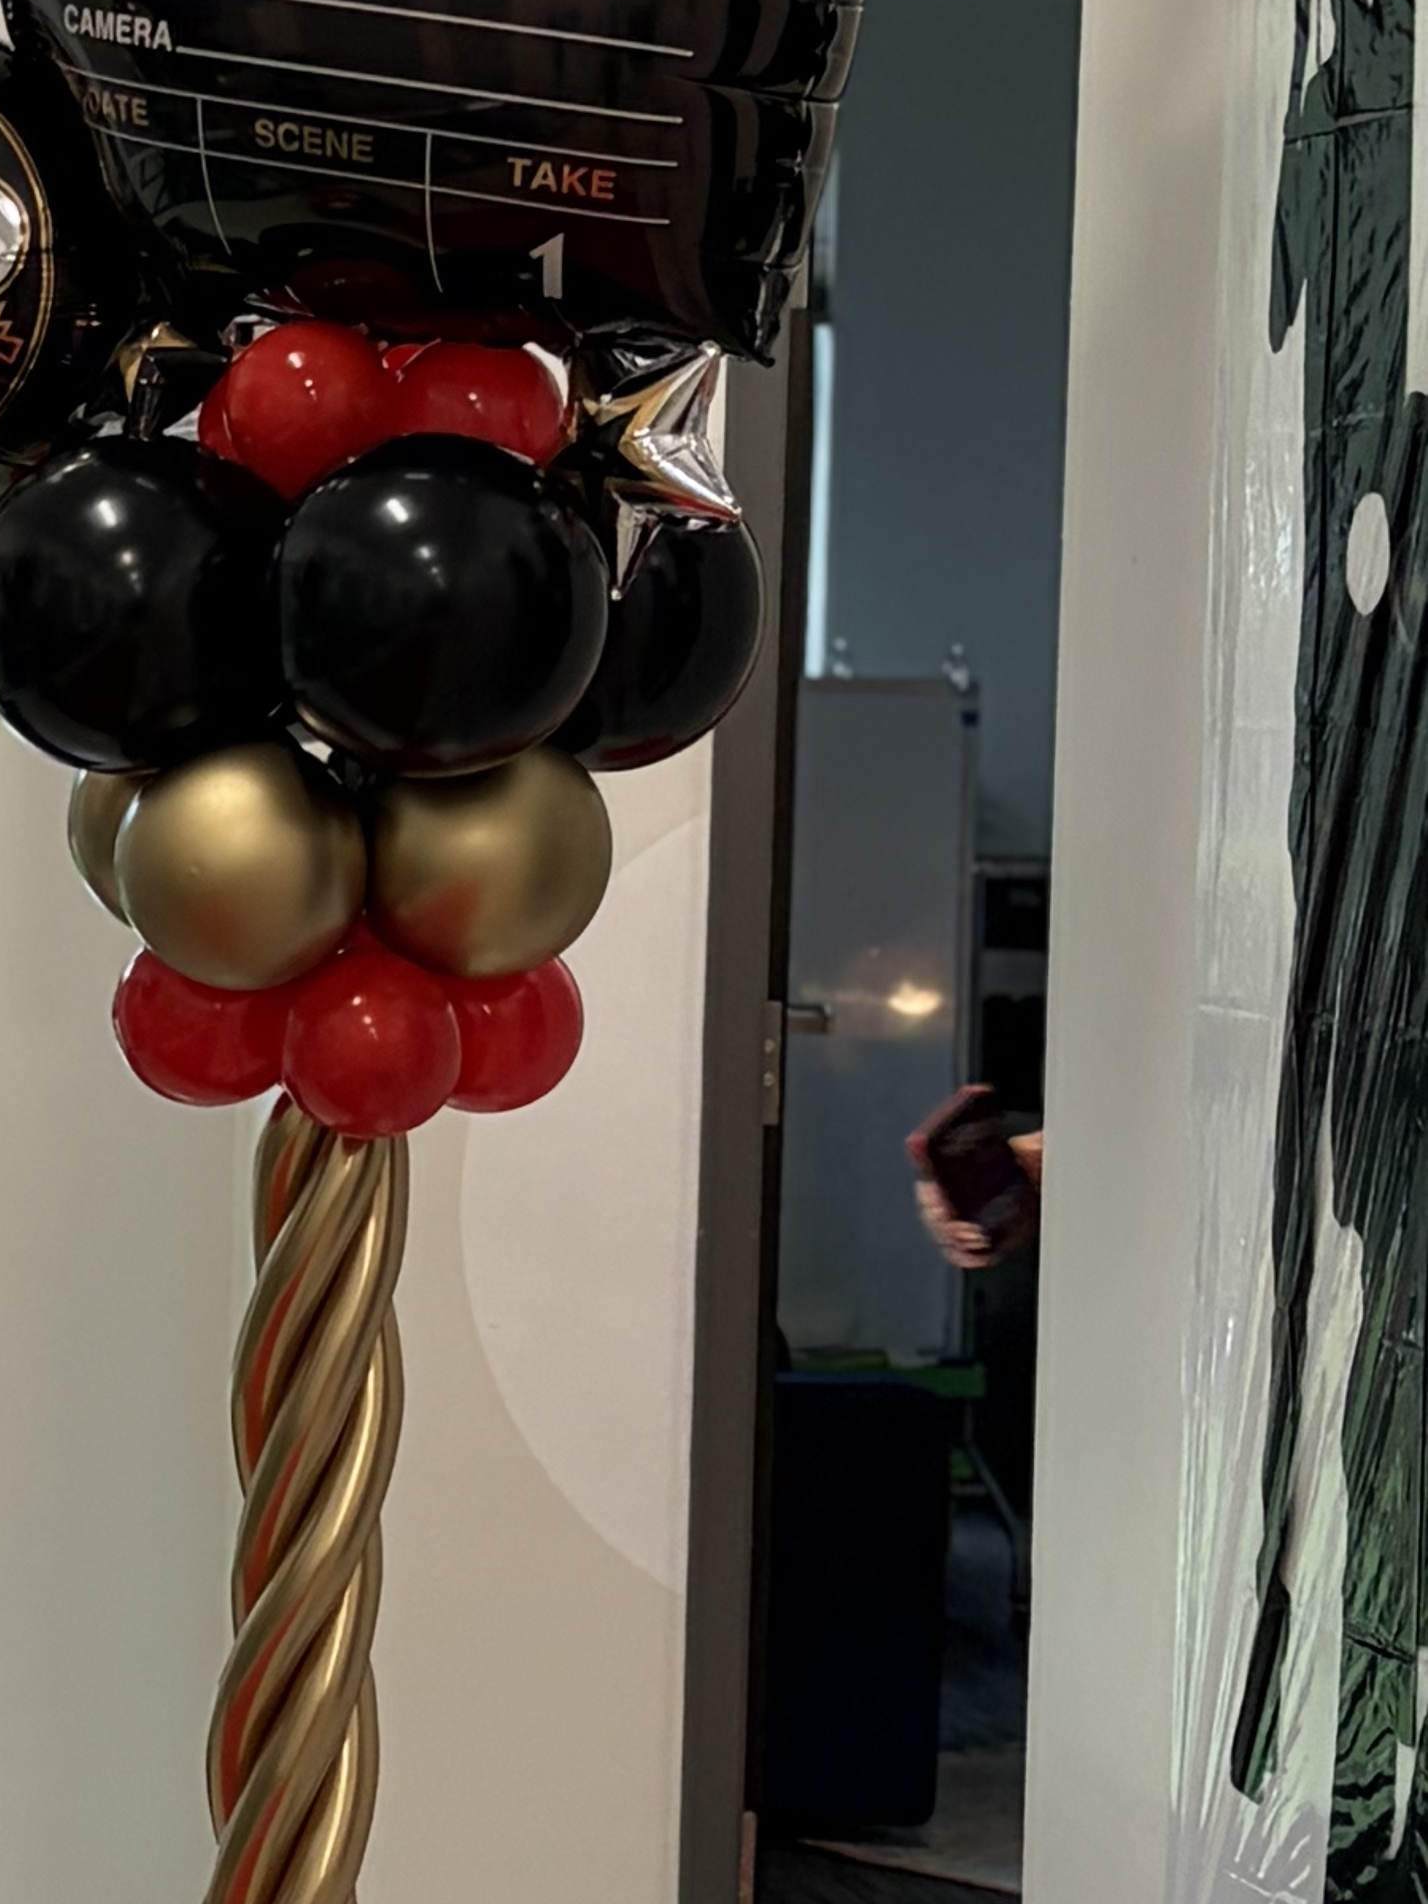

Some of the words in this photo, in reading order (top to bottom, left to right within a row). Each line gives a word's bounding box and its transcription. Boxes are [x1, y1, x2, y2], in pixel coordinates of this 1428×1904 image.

[63, 3, 173, 53] CAMERA
[254, 118, 375, 164] SCENE
[507, 157, 618, 201] TAKE
[529, 232, 564, 300] 1
